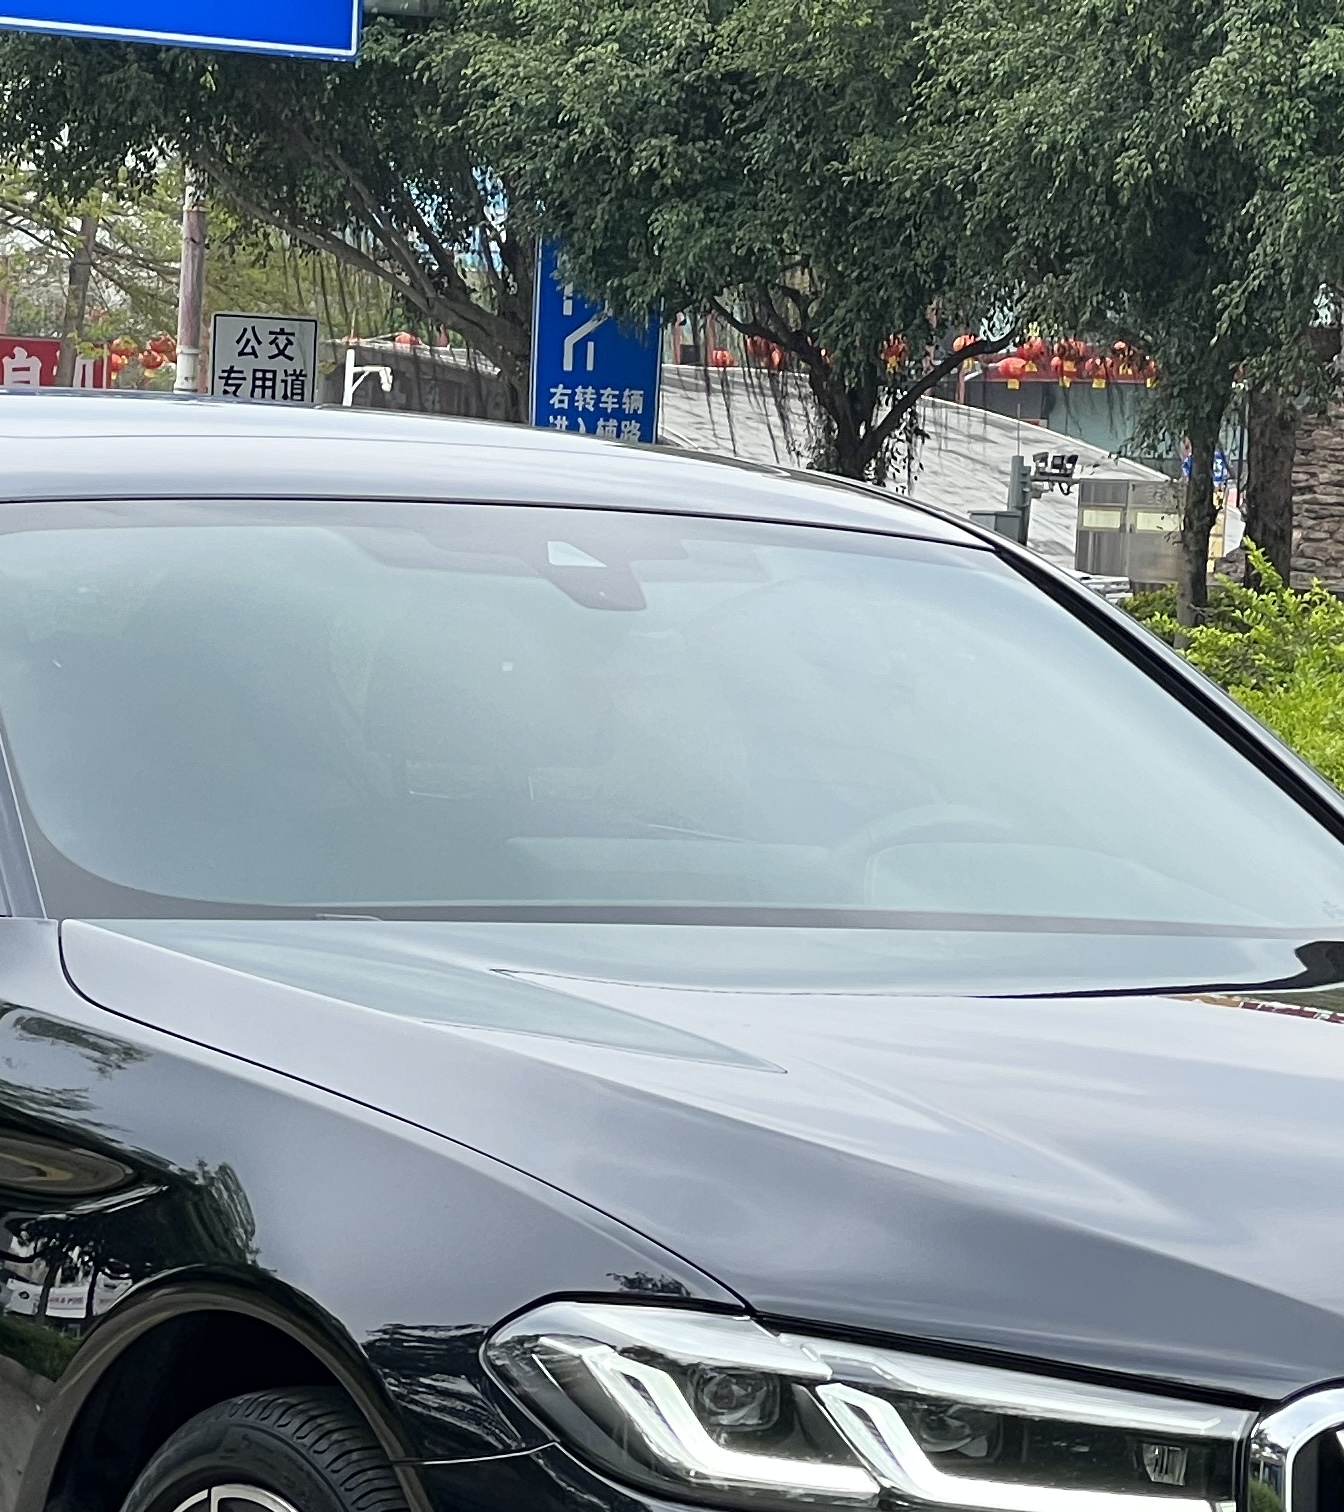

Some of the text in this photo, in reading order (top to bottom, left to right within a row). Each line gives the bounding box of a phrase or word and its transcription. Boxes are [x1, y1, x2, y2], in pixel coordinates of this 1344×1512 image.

[236, 326, 295, 361] 公交
[218, 365, 307, 401] 专用道
[549, 384, 644, 414] 右转车辆
